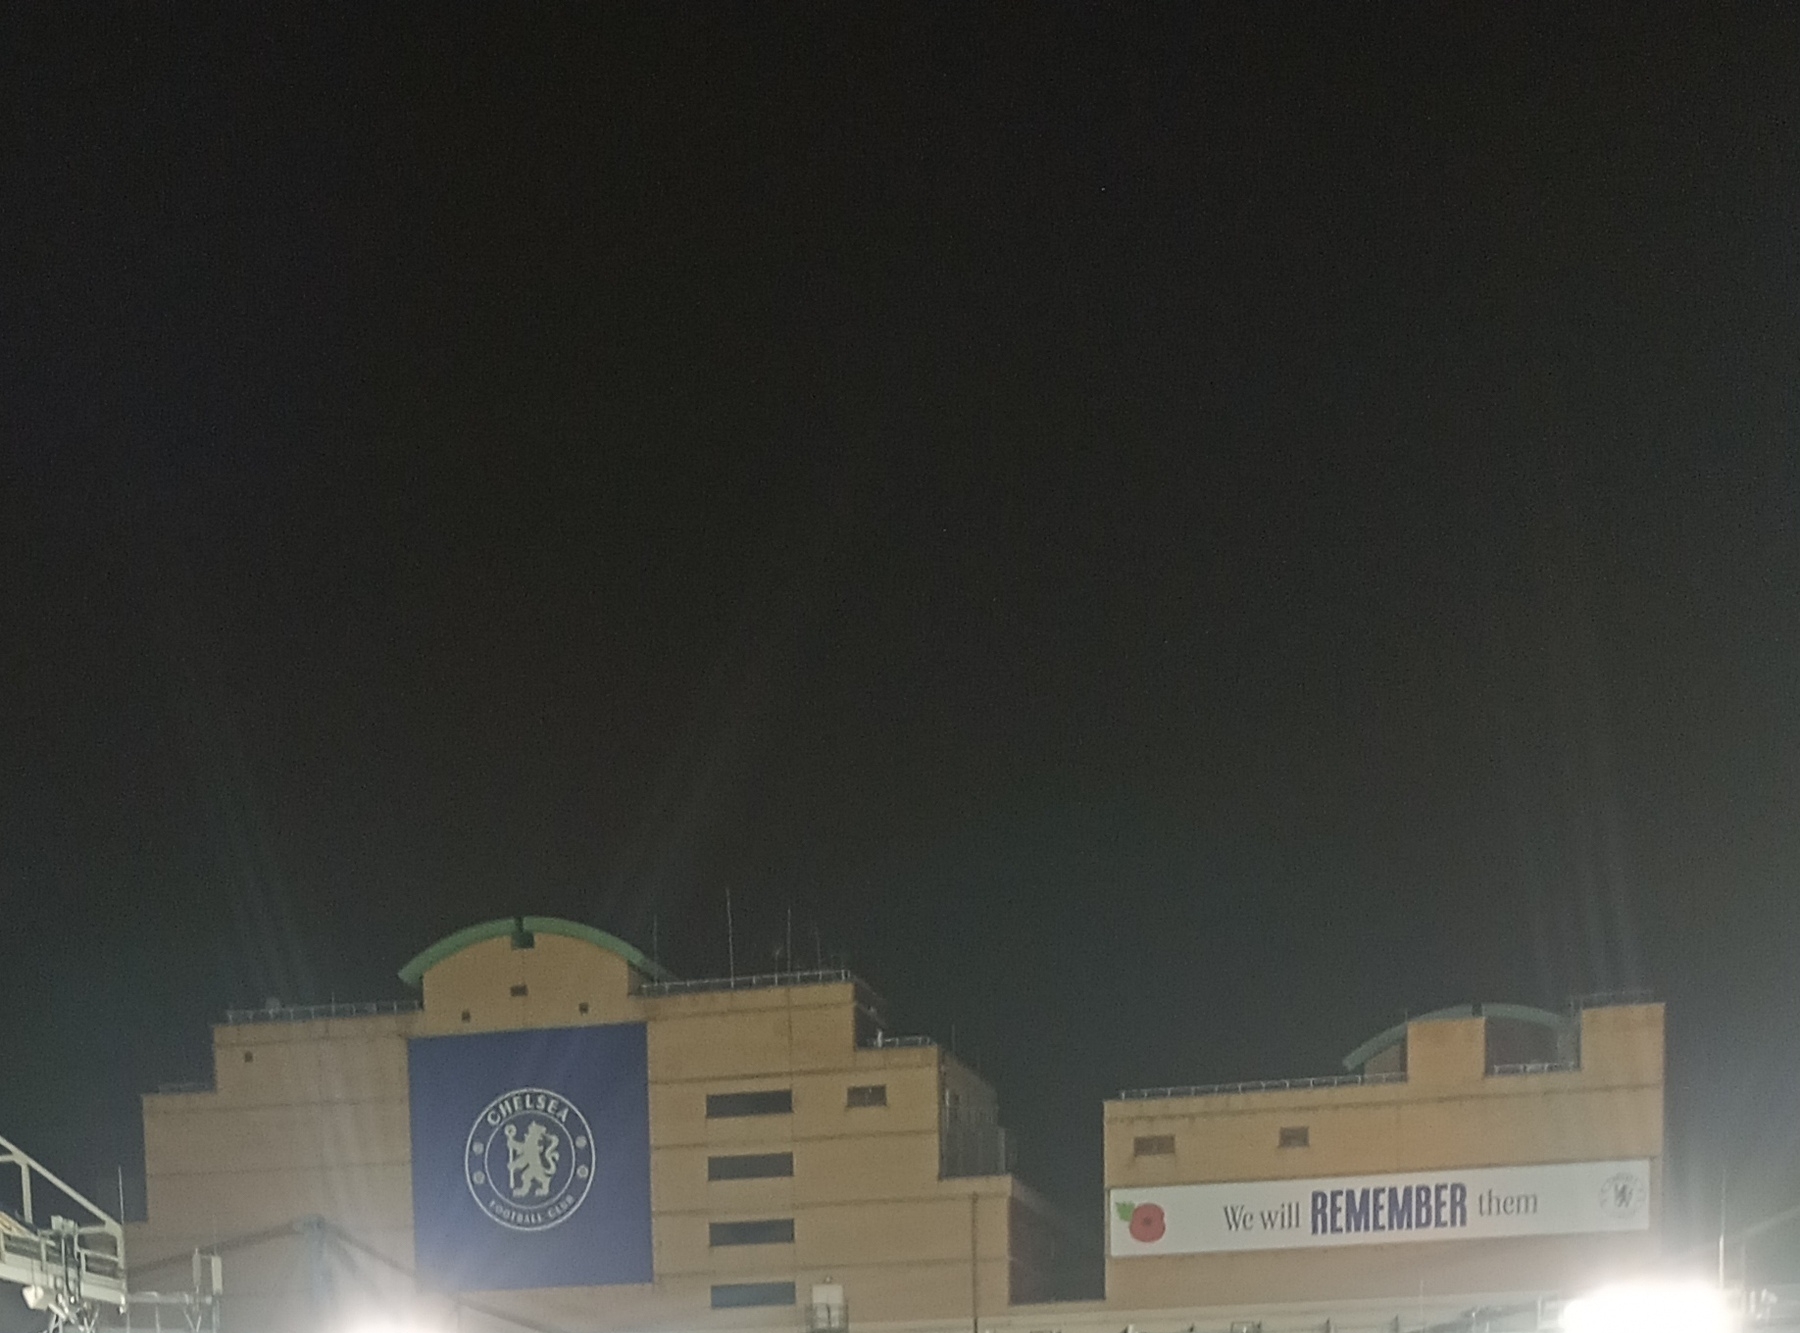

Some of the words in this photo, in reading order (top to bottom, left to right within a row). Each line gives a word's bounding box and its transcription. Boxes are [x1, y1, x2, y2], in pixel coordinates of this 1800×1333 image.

[487, 1094, 570, 1126] CHELSEA
[488, 1199, 542, 1225] FOOTBALL
[547, 1194, 575, 1217] CLUB
[1223, 1204, 1254, 1231] We
[1259, 1201, 1301, 1229] will
[1310, 1182, 1468, 1235] REMEMBER
[1477, 1189, 1539, 1217] them
